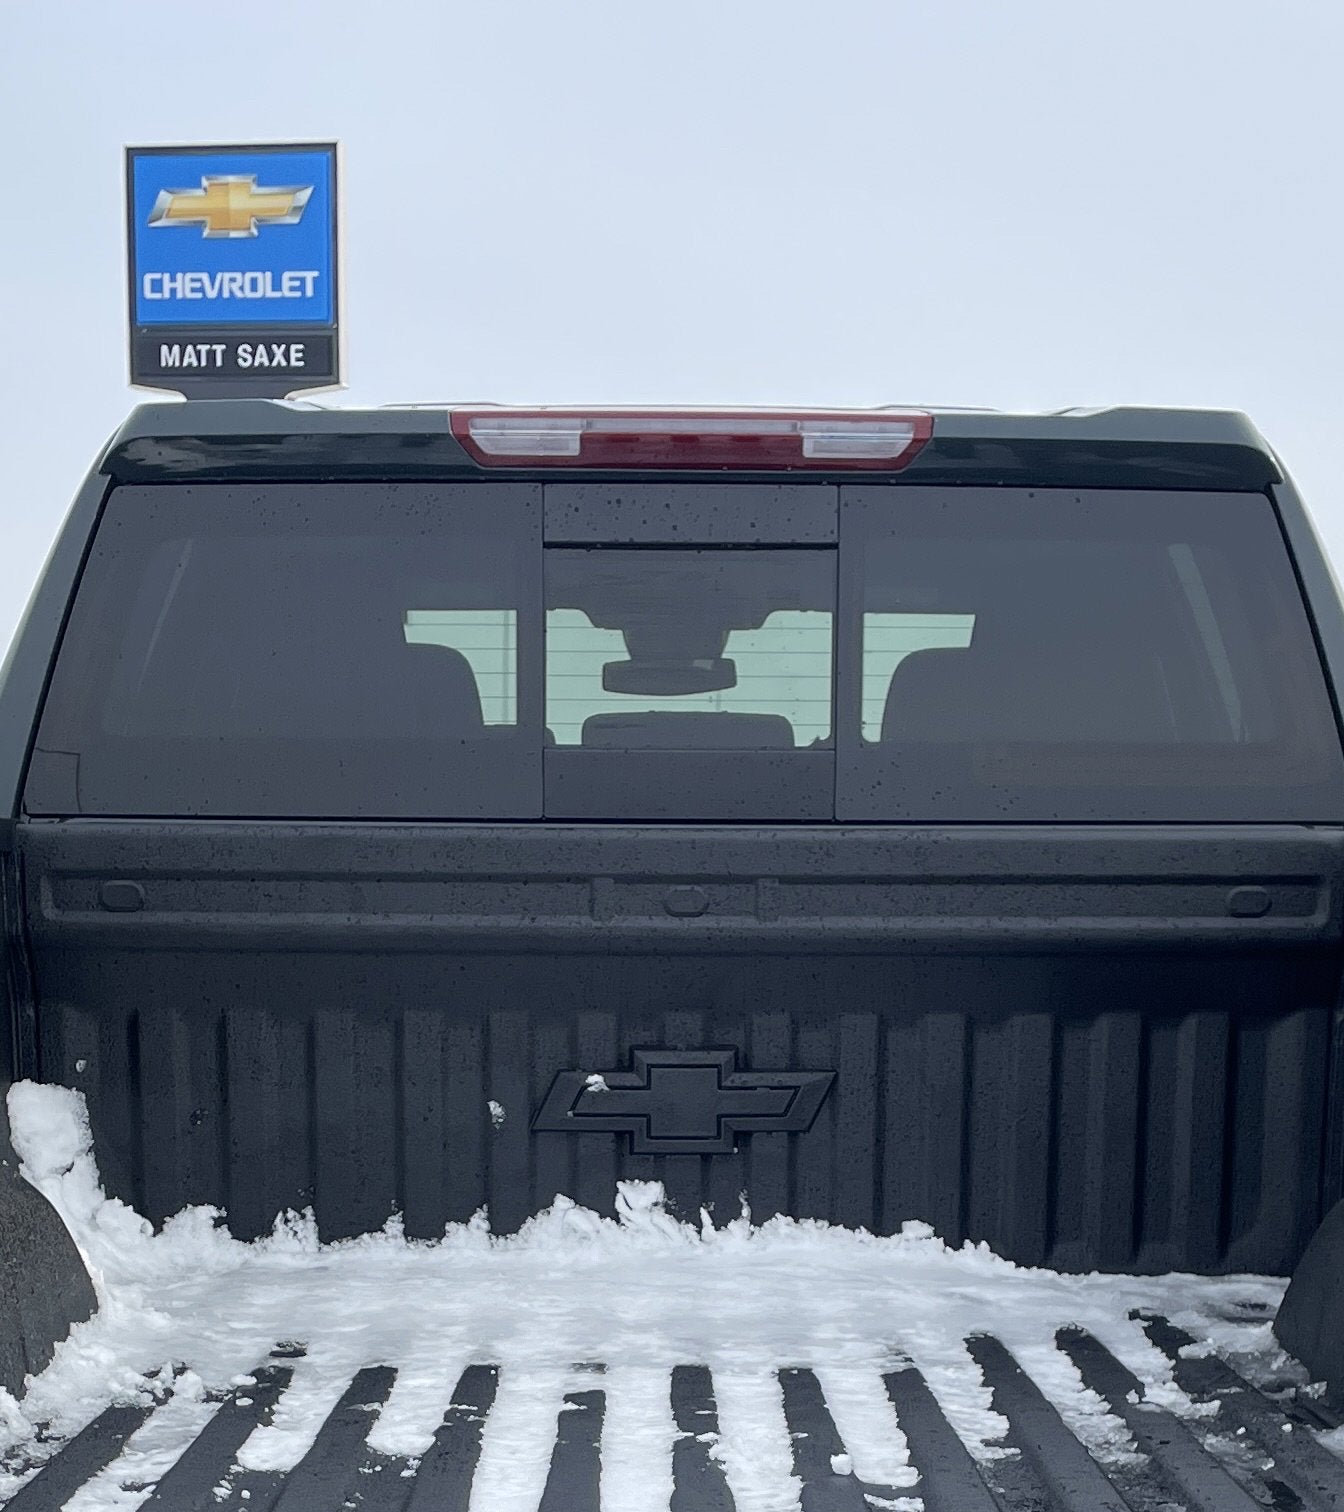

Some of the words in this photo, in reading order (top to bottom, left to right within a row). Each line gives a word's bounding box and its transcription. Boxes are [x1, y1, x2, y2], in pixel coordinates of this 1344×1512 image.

[143, 270, 320, 299] CHEVROLET
[160, 344, 226, 367] MATT
[237, 343, 305, 367] SAXE
